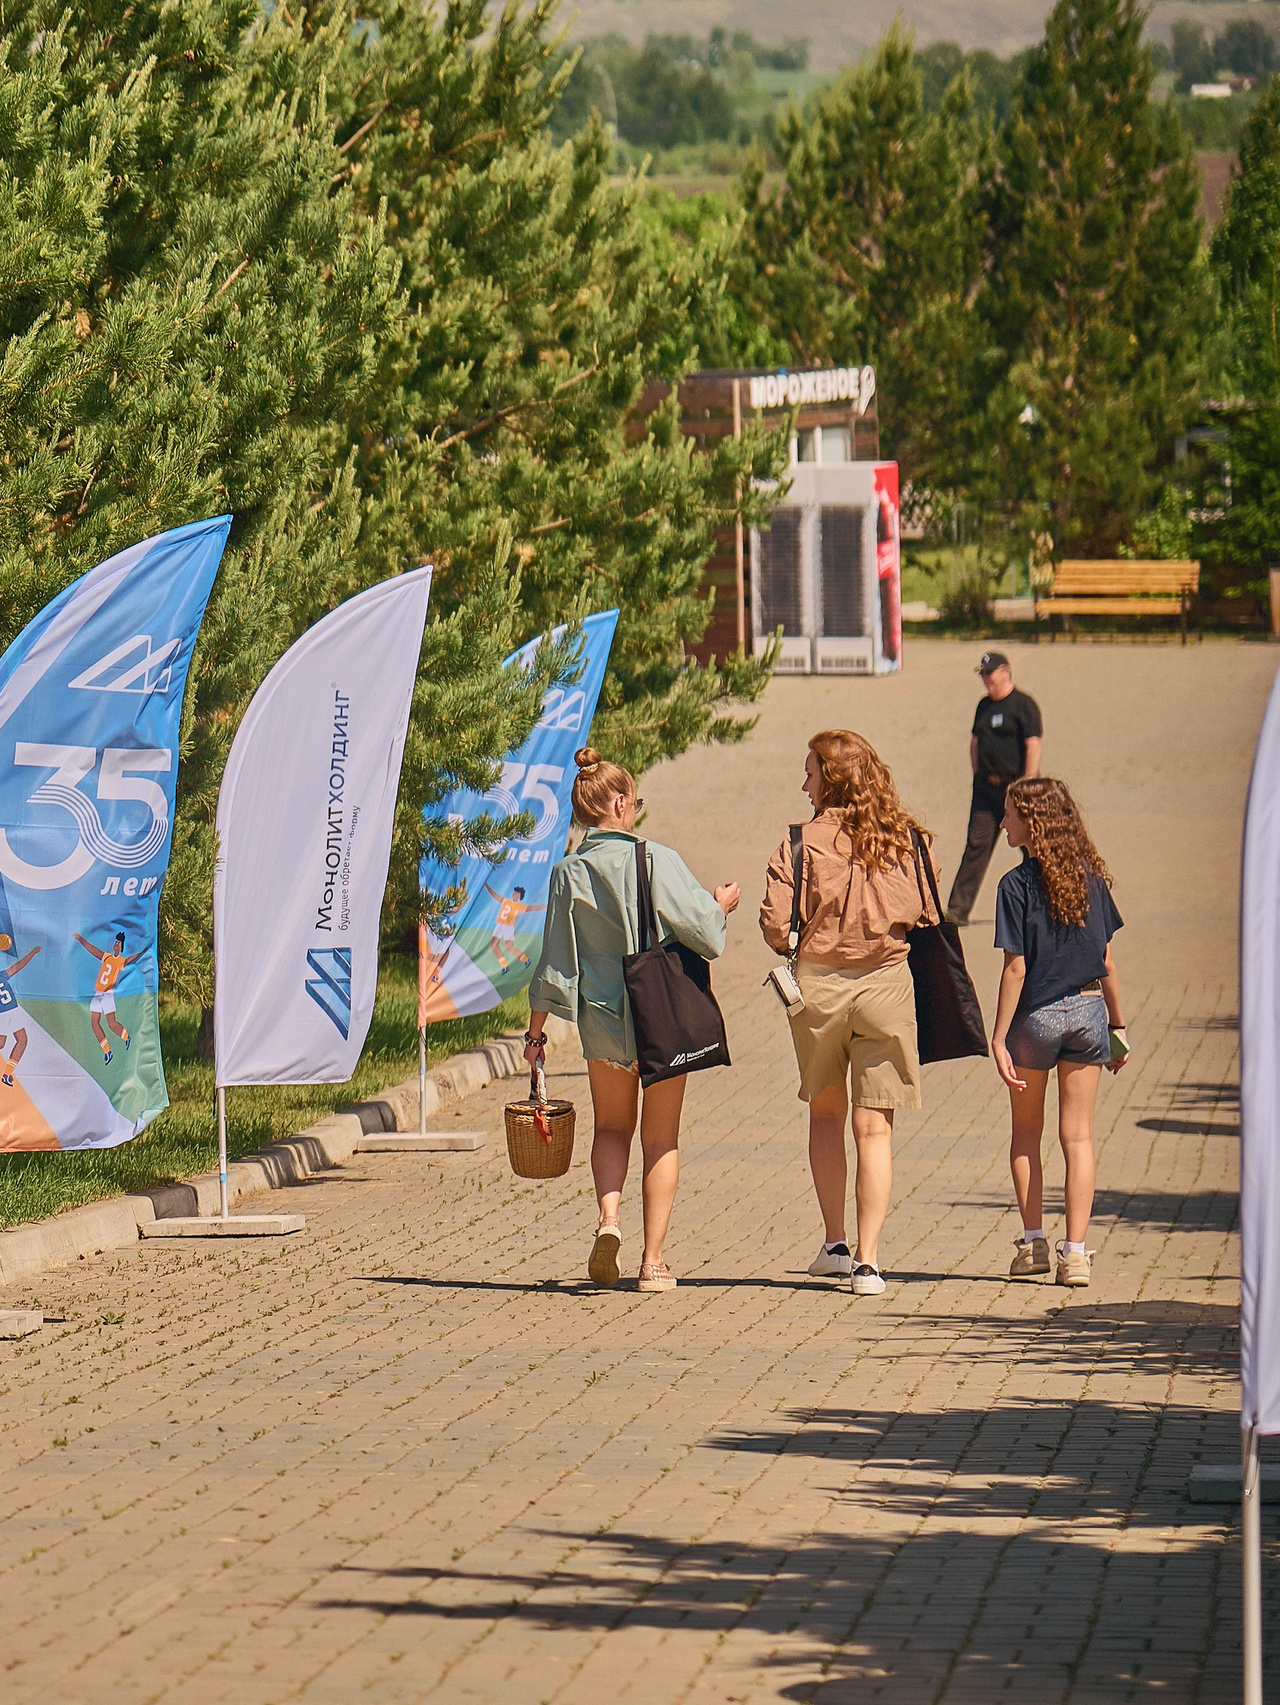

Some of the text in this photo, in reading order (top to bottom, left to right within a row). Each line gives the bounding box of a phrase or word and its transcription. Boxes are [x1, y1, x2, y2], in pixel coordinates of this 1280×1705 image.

[750, 368, 859, 408] МОРОЖЕНОЕ
[100, 876, 157, 895] лет
[339, 888, 350, 931] будущее
